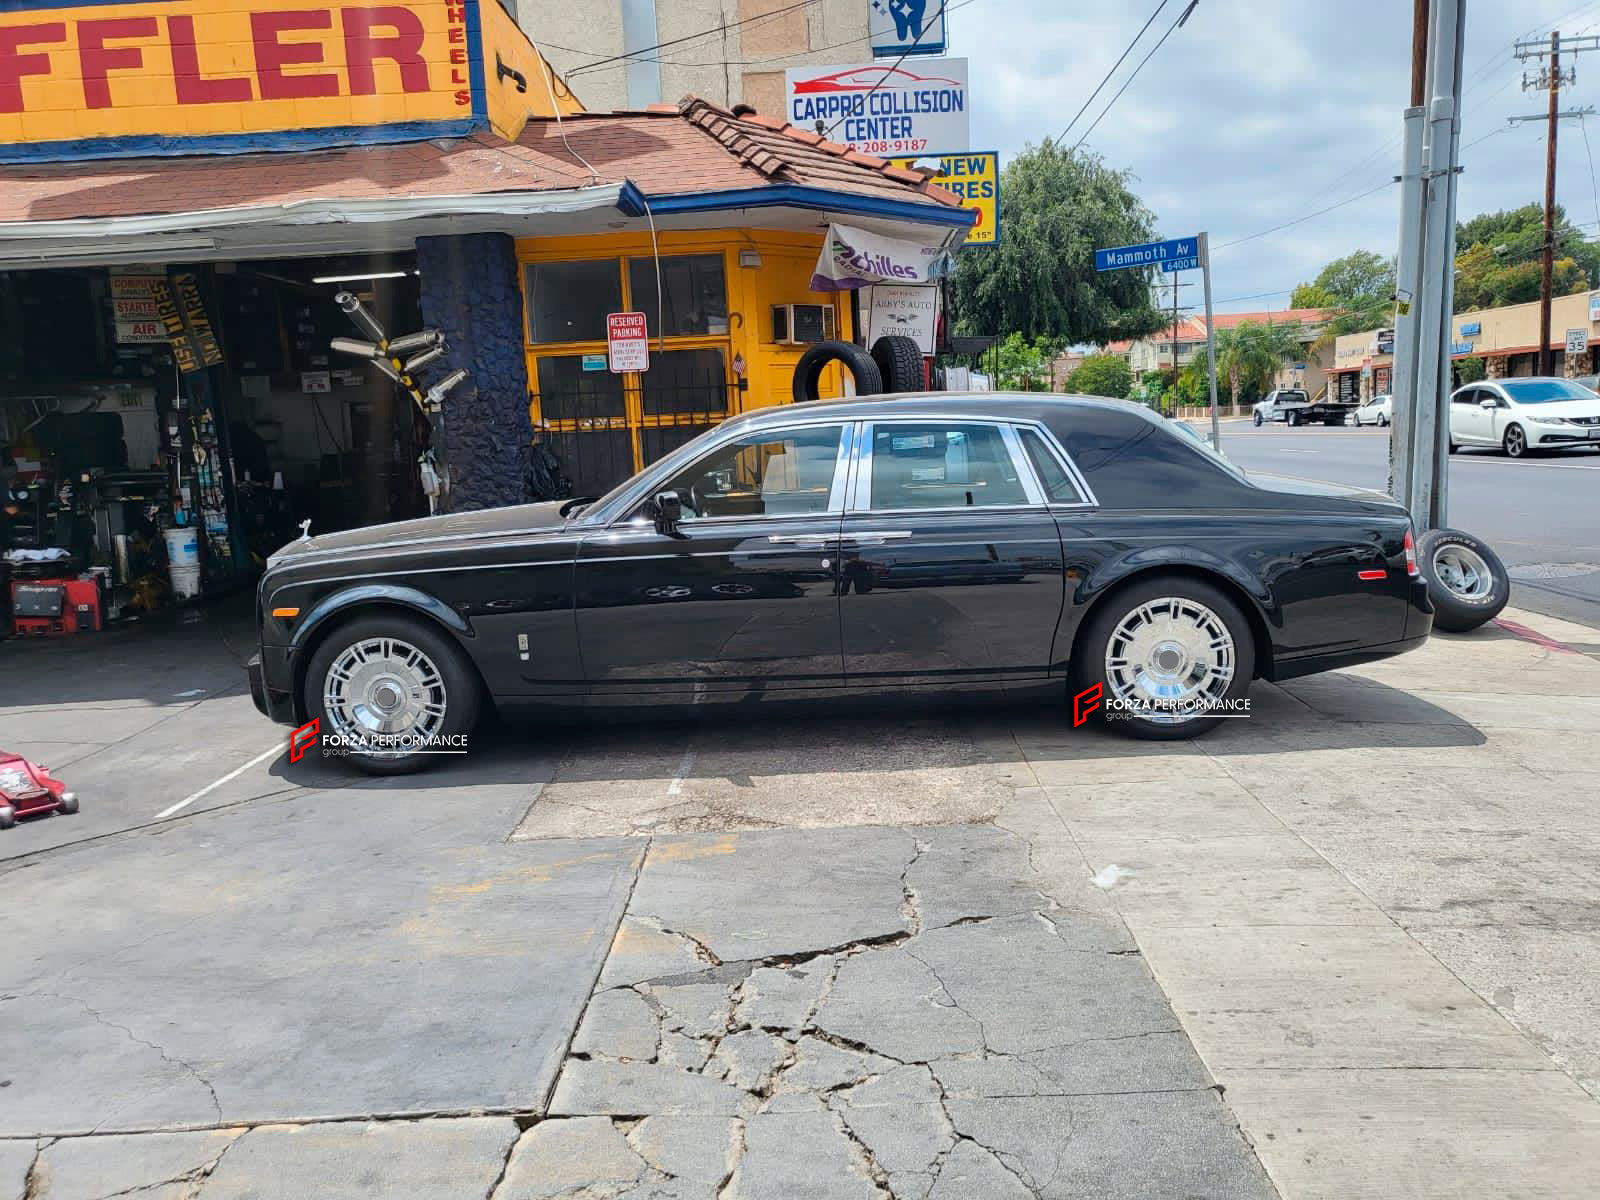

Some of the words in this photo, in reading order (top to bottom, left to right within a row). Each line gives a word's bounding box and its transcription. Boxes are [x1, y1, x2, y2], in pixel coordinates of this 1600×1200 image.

[793, 94, 865, 120] CARPRO
[869, 89, 963, 116] COLLISION
[845, 116, 913, 142] CENTER
[940, 157, 987, 177] NEW
[1106, 246, 1167, 266] Mammoth
[1176, 242, 1189, 256] Av
[1167, 259, 1190, 271] 6400
[1190, 258, 1198, 268] W
[610, 316, 644, 326] RESERVED
[132, 323, 157, 335] AIR
[613, 328, 642, 337] PARKING
[1568, 341, 1585, 352] 35
